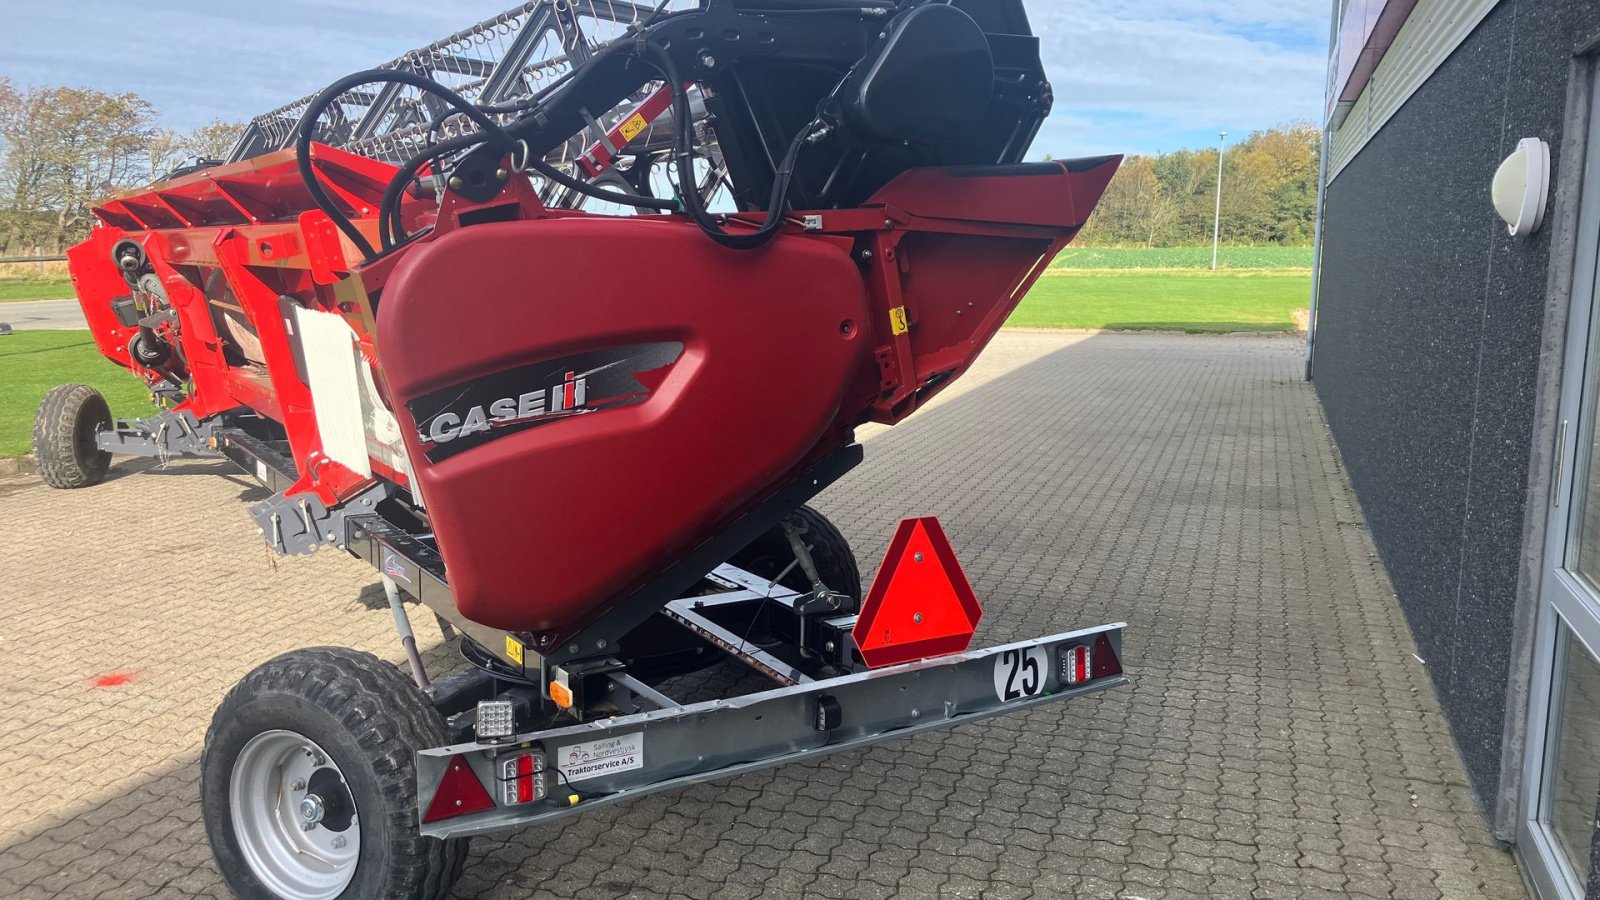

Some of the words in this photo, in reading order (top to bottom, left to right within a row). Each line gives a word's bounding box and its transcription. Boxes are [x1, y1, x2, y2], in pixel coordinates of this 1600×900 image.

[429, 389, 546, 443] CASE
[1003, 645, 1039, 701] 25
[567, 760, 620, 776] Traktorservice
[621, 756, 635, 766] A/S
